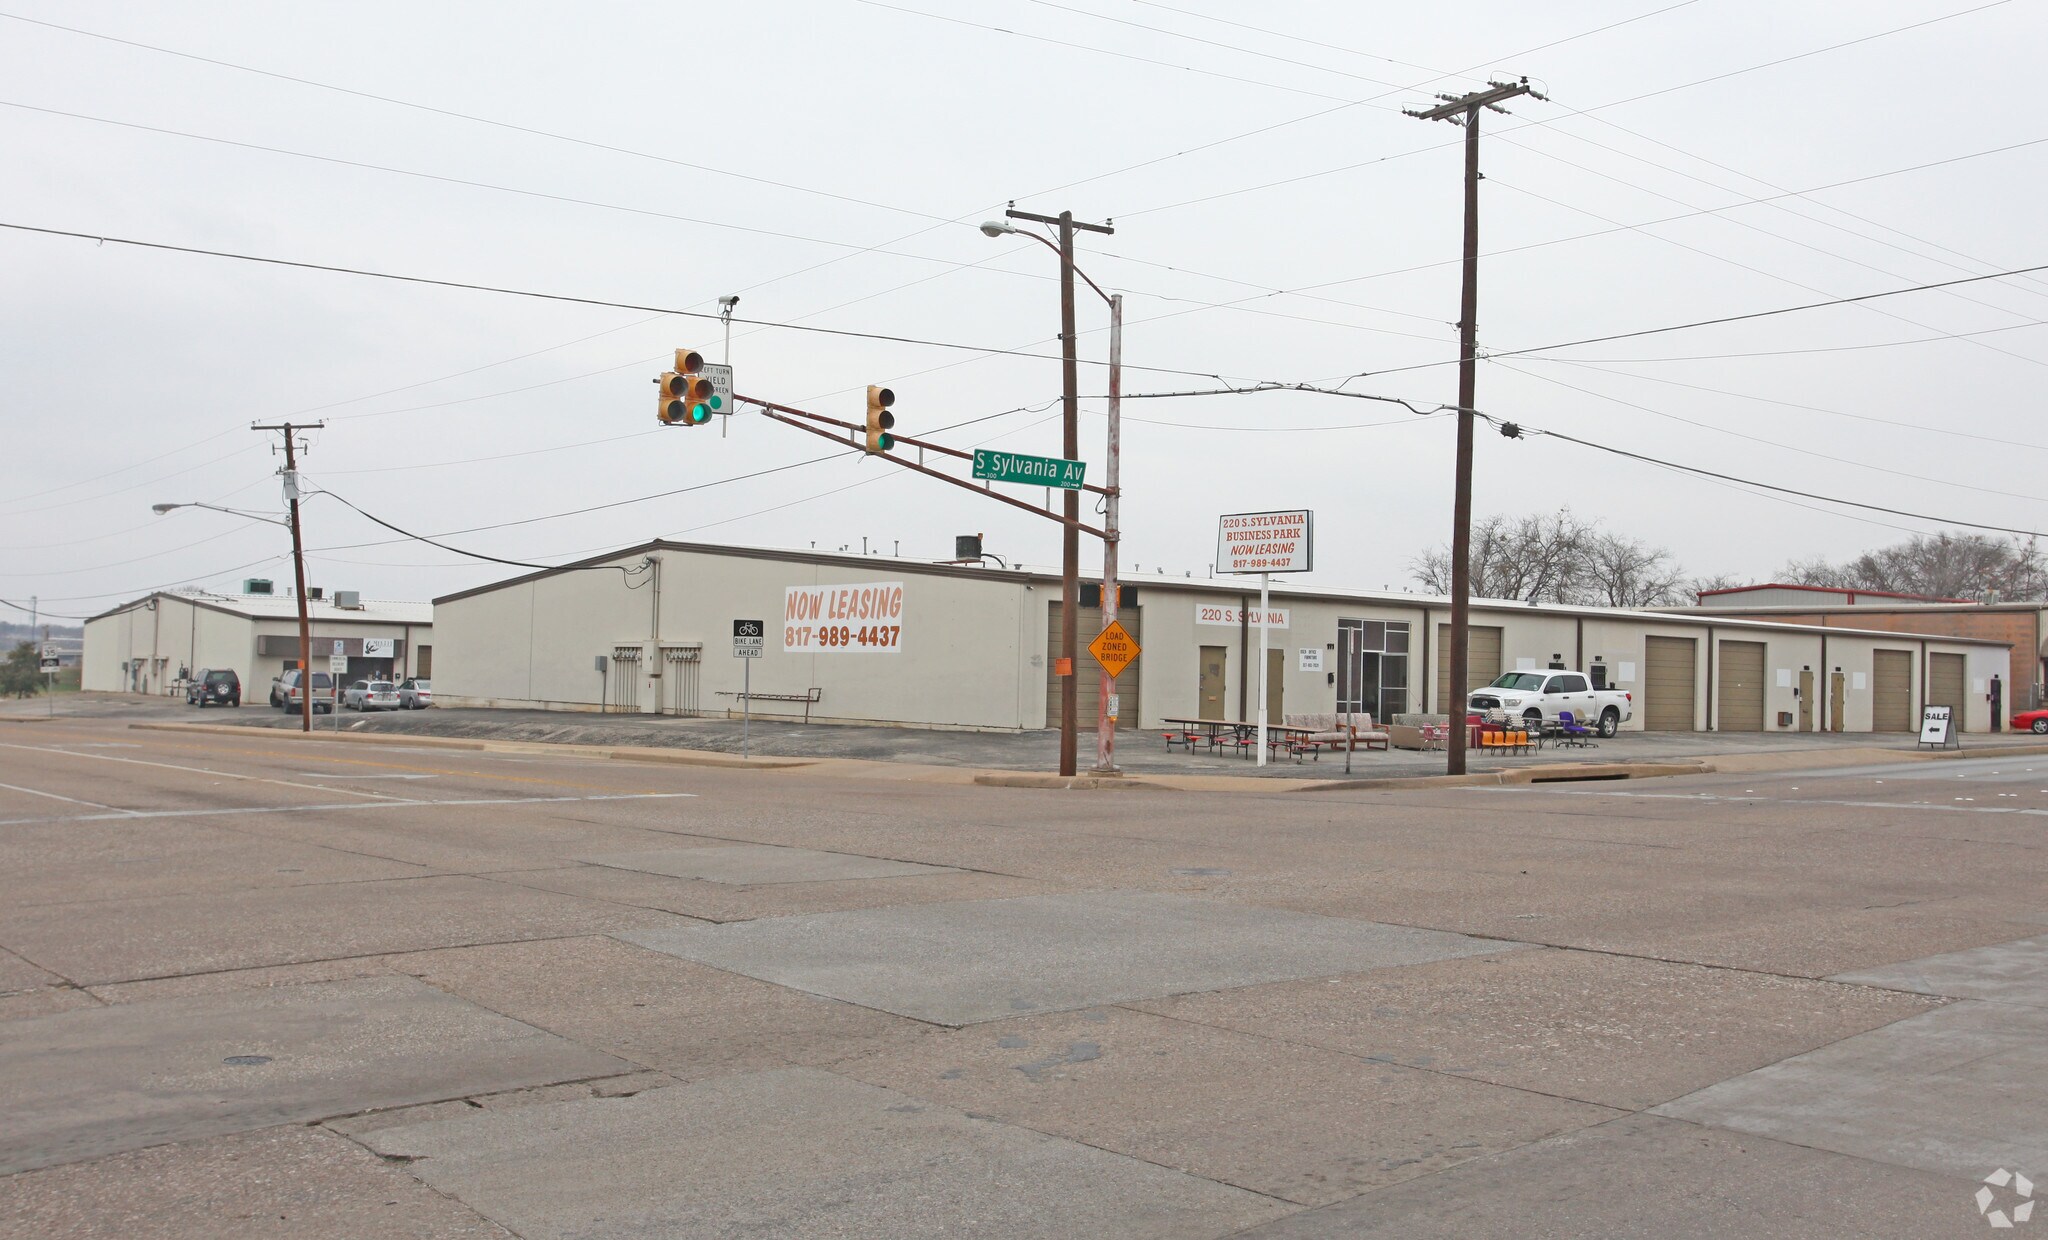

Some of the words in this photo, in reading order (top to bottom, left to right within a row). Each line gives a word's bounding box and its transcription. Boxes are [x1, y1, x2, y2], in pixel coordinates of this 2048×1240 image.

[716, 367, 730, 375] TURN
[705, 375, 726, 385] YIELD
[976, 452, 985, 470] S
[992, 453, 1057, 477] Sylvania
[1063, 463, 1083, 481] Av
[1223, 518, 1240, 529] 220
[1226, 529, 1271, 542] BUSINESS
[1273, 528, 1301, 539] PARK
[1230, 544, 1254, 556] NOW
[1255, 542, 1295, 555] LEASING
[1232, 558, 1291, 568] 817-989-4437
[785, 591, 824, 622] NOW
[828, 586, 903, 620] LEASING
[1201, 608, 1222, 621] 220
[1225, 610, 1234, 622] S.
[785, 625, 900, 647] 817-989-4437
[1105, 631, 1124, 640] LOAD
[734, 637, 747, 645] BIKE
[1102, 642, 1127, 651] ZONED
[1100, 653, 1127, 662] BRIDGE
[1924, 712, 1950, 721] SALE
